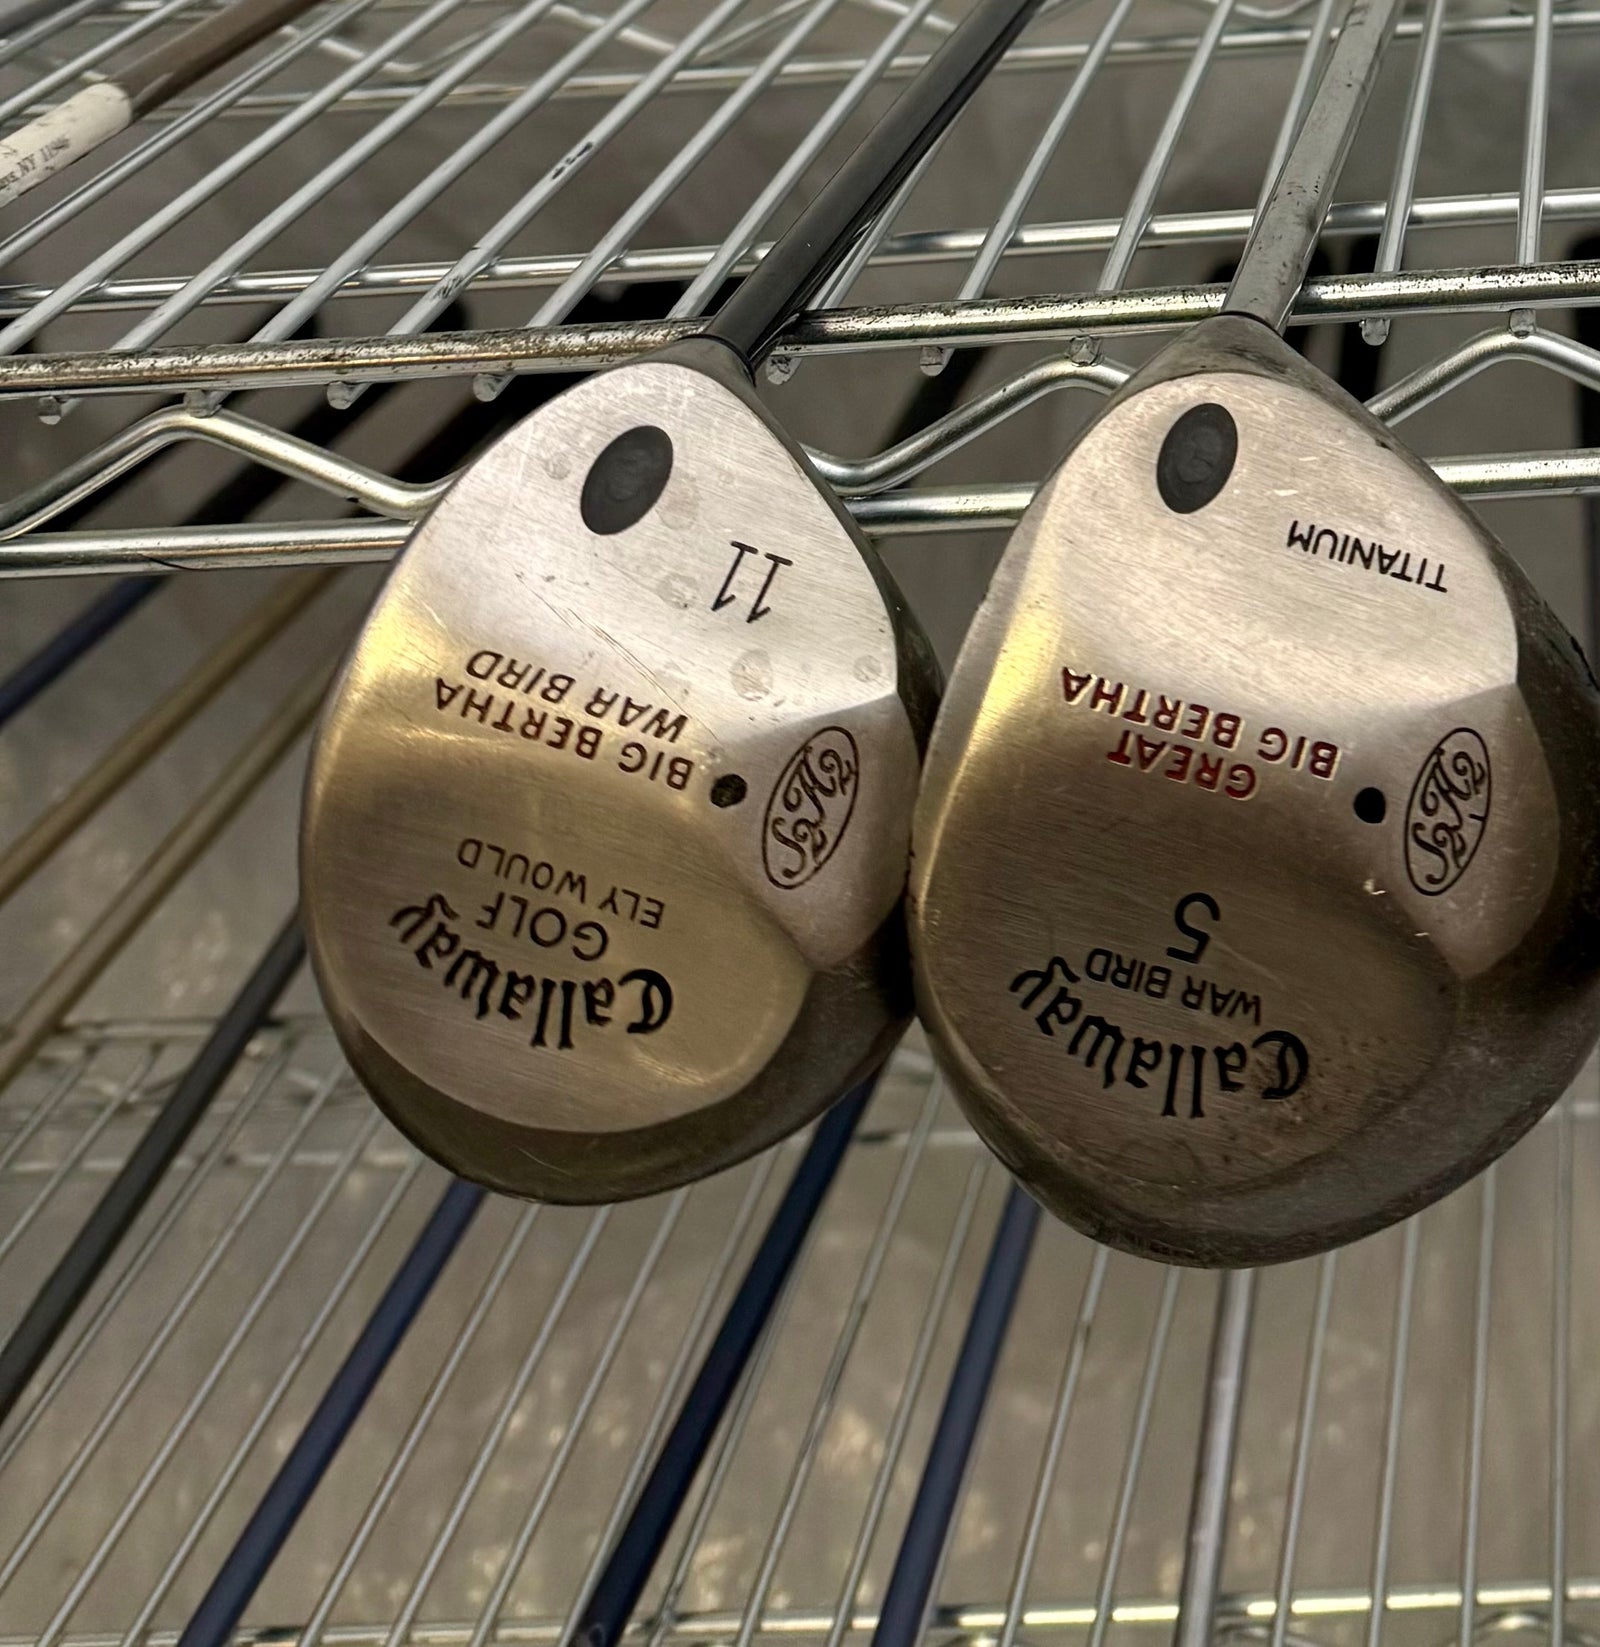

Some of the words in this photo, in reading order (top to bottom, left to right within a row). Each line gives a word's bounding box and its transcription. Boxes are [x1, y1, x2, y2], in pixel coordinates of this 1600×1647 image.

[710, 540, 794, 624] 11
[1287, 519, 1448, 593] TITANIUM
[466, 649, 576, 705] BIRD
[1062, 666, 1244, 750] BERTHA
[435, 677, 603, 761] BERTHA
[584, 687, 691, 742] WAR
[616, 741, 694, 791] BIG
[1107, 730, 1257, 800] GREAT
[1259, 728, 1339, 779] BIG
[458, 837, 587, 897] WOULD
[476, 890, 609, 961] GOLF
[599, 885, 665, 930] ELY
[1166, 892, 1221, 966] 5
[388, 893, 675, 1050] Callaway
[1085, 948, 1170, 1000] BIRD
[1180, 976, 1261, 1026] WAR
[1010, 956, 1310, 1120] Callaway
